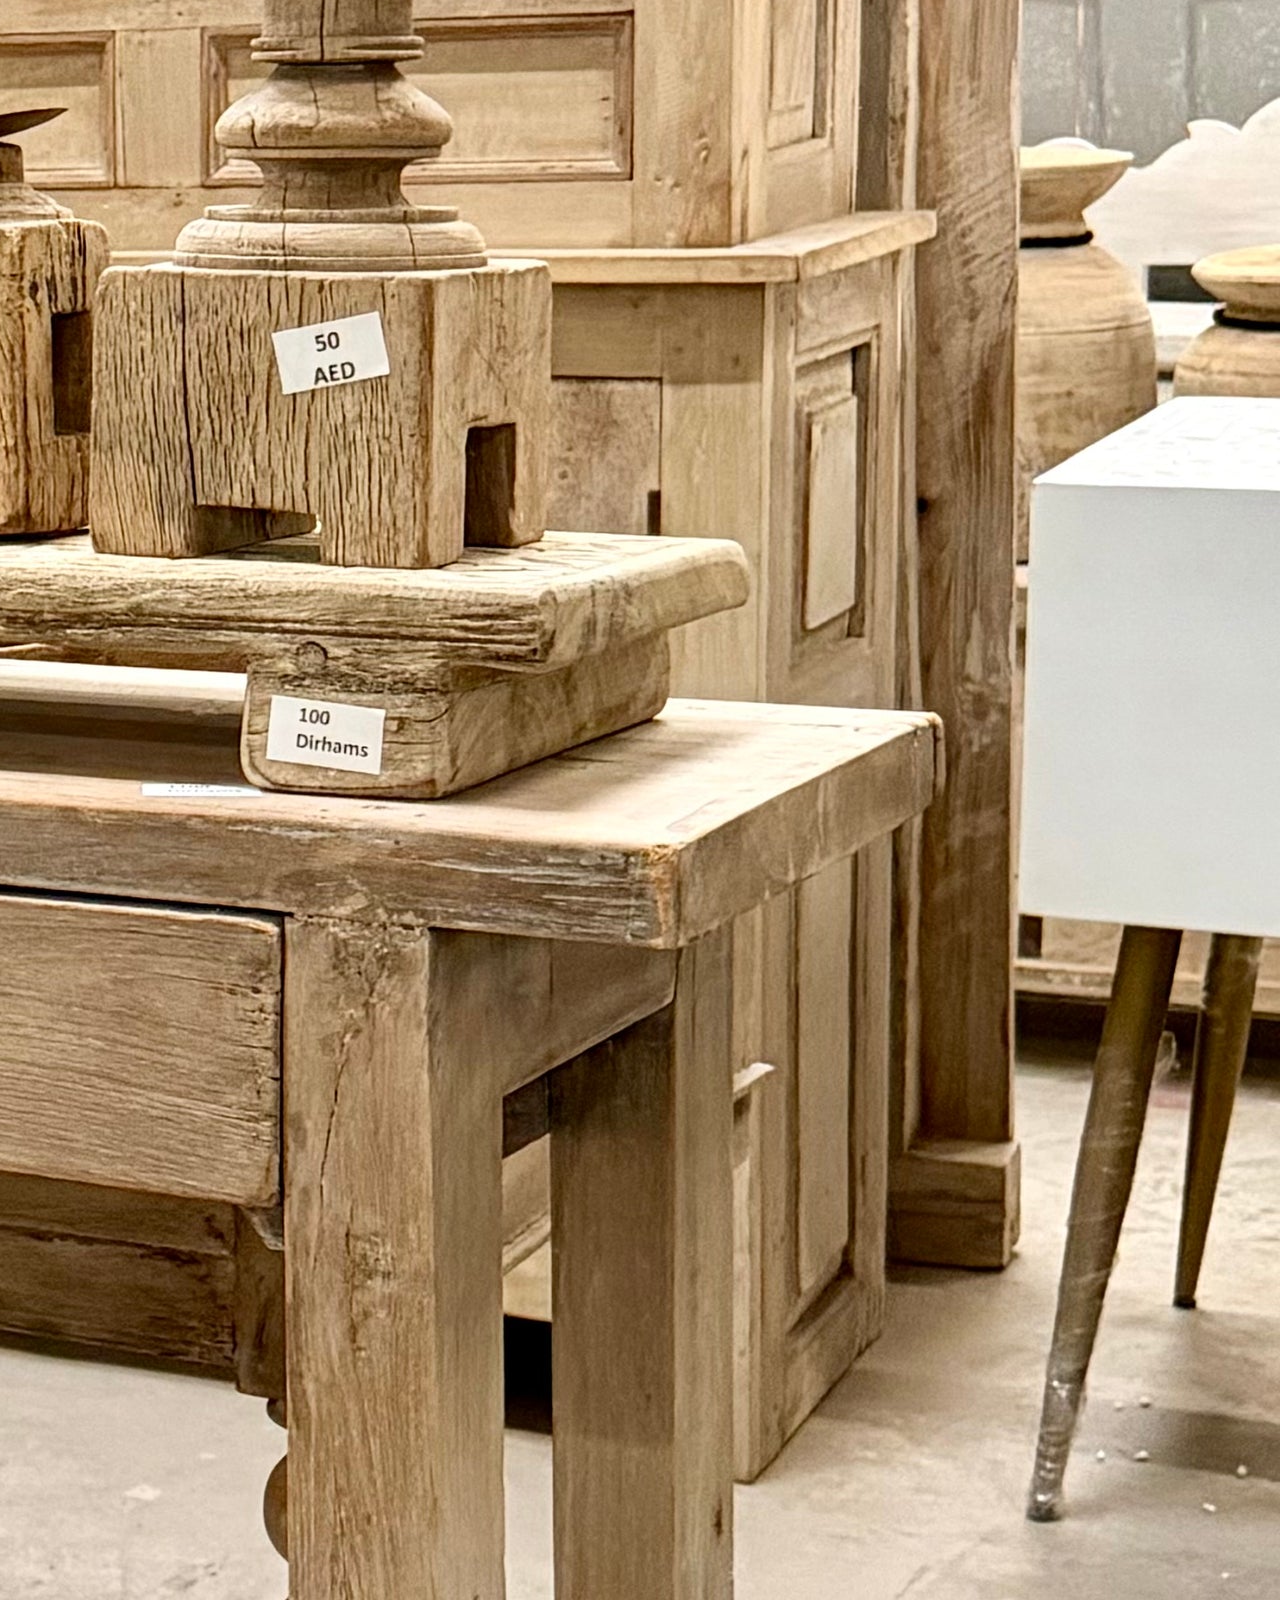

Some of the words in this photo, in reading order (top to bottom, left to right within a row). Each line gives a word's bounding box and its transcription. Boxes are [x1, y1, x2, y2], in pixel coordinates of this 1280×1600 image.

[314, 331, 340, 352] 50
[314, 361, 356, 386] AED
[298, 707, 331, 726] 100
[295, 733, 370, 758] Dirhams
